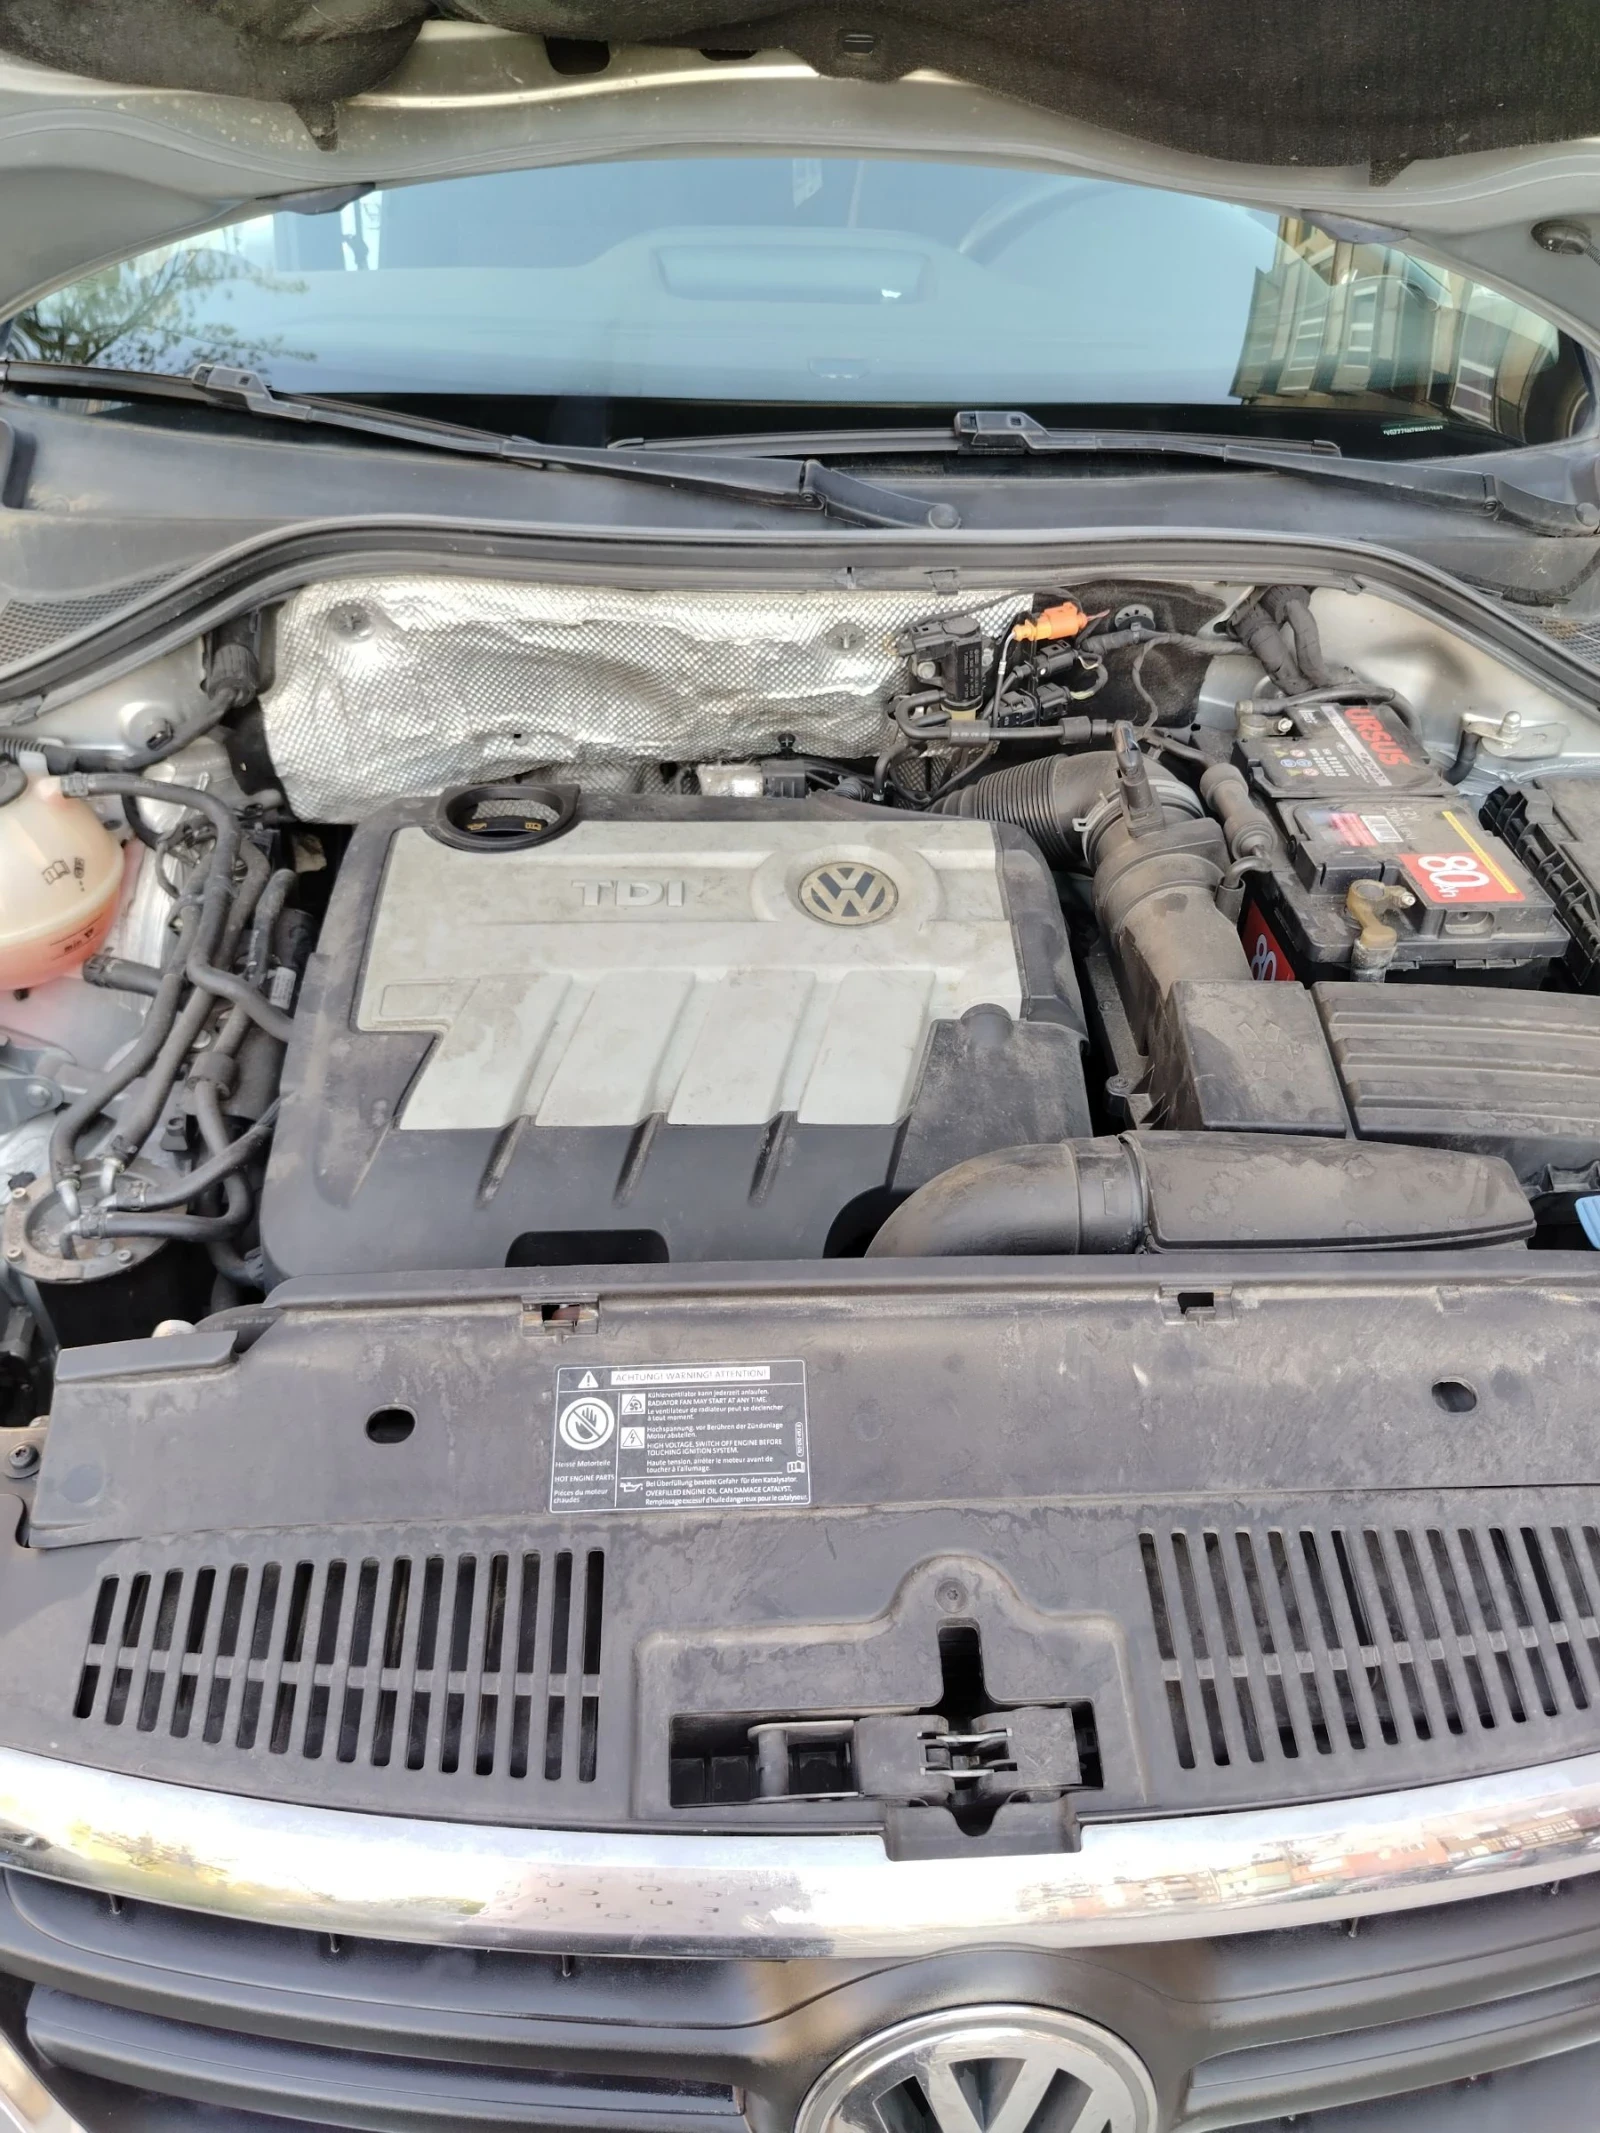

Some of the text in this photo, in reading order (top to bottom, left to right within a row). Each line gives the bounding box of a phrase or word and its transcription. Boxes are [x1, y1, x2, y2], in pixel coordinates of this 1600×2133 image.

[1344, 707, 1411, 765] URSUS
[572, 879, 686, 907] TDI
[800, 863, 898, 925] VW
[615, 1369, 767, 1382] ACHTUNG! WARNING! ATTENTION!
[714, 1390, 740, 1398] jederzeit
[740, 1388, 770, 1396] anlaufen.
[728, 1406, 742, 1414] peut
[746, 1422, 784, 1430] Zündanlage
[758, 1438, 782, 1446] BEFORE
[667, 1458, 693, 1466] tension,
[570, 1474, 595, 1482] ENGINE
[646, 1480, 656, 1488] Bei
[694, 1478, 717, 1486] besteht
[750, 1476, 762, 1484] den
[646, 1488, 682, 1496] OVERFILLED
[682, 1488, 706, 1496] ENGINE
[734, 1486, 762, 1494] DAMAGE
[553, 1496, 580, 1504] chaudes
[646, 1498, 682, 1506] Remplissage
[726, 1496, 757, 1504] dangereux
